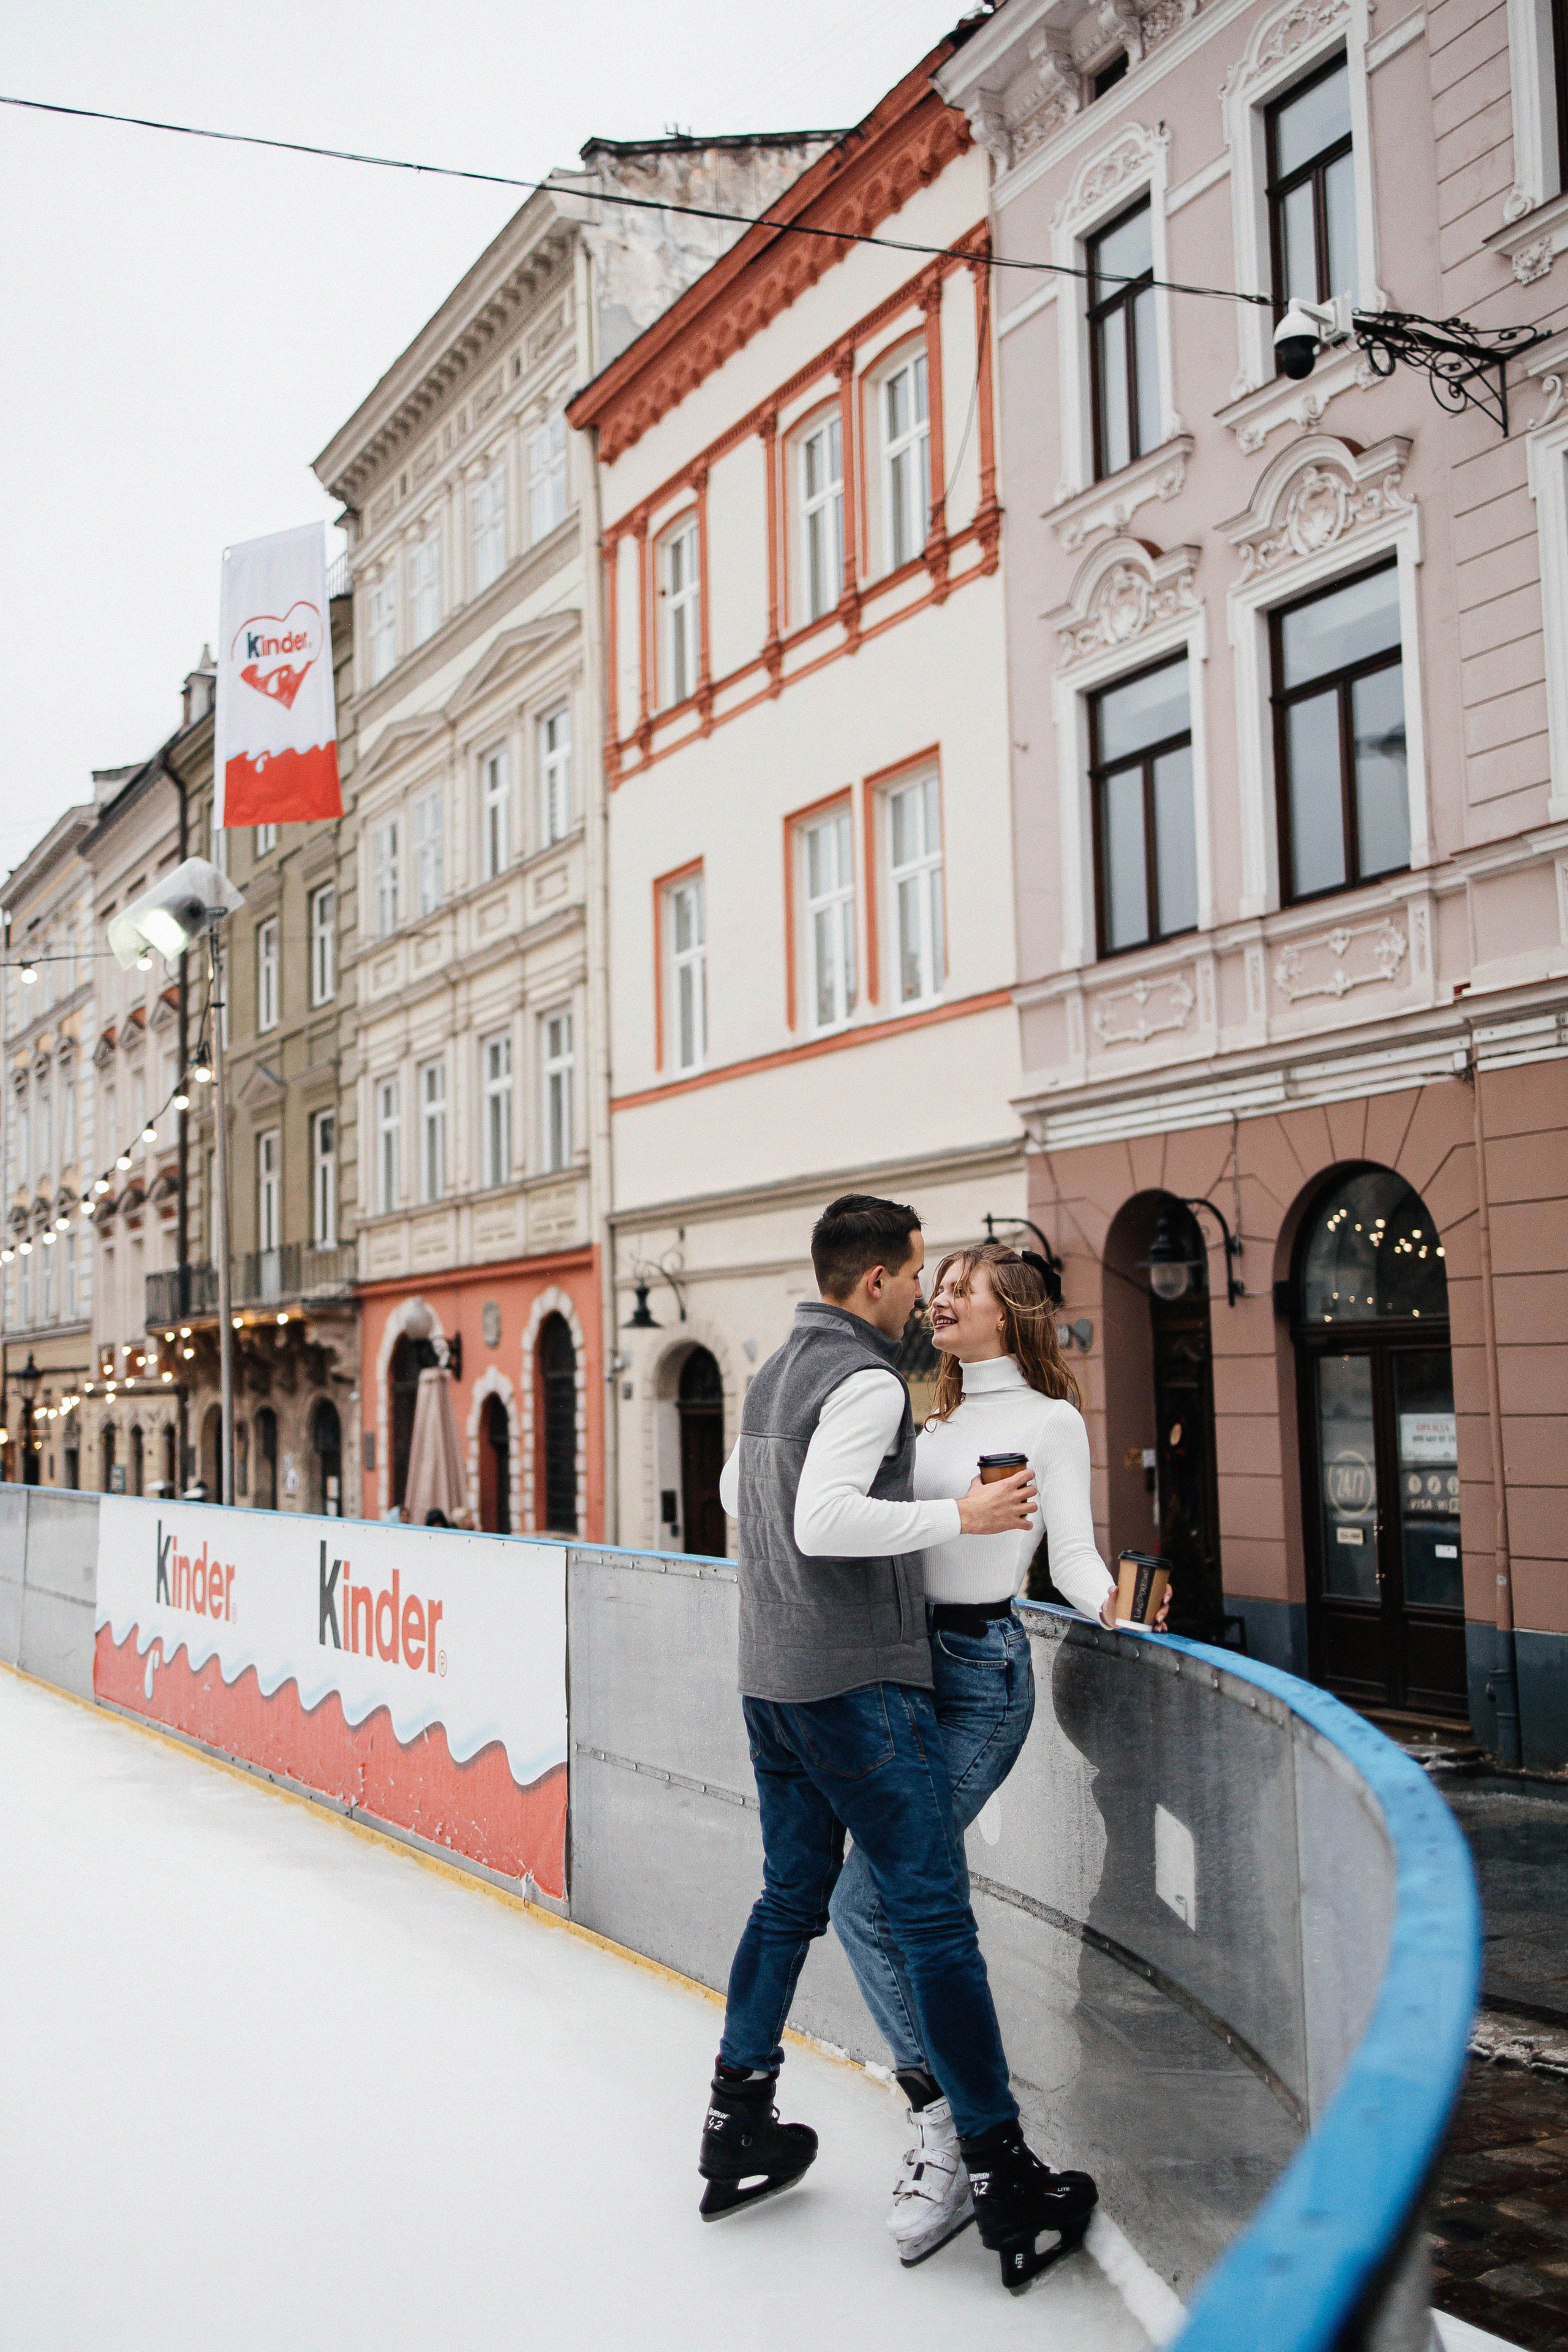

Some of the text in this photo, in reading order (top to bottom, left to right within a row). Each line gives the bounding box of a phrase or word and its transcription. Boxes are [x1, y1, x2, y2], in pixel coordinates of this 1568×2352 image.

[708, 2116, 723, 2130] 42
[969, 2172, 990, 2182] TEMPISH
[973, 2181, 988, 2196] 42
